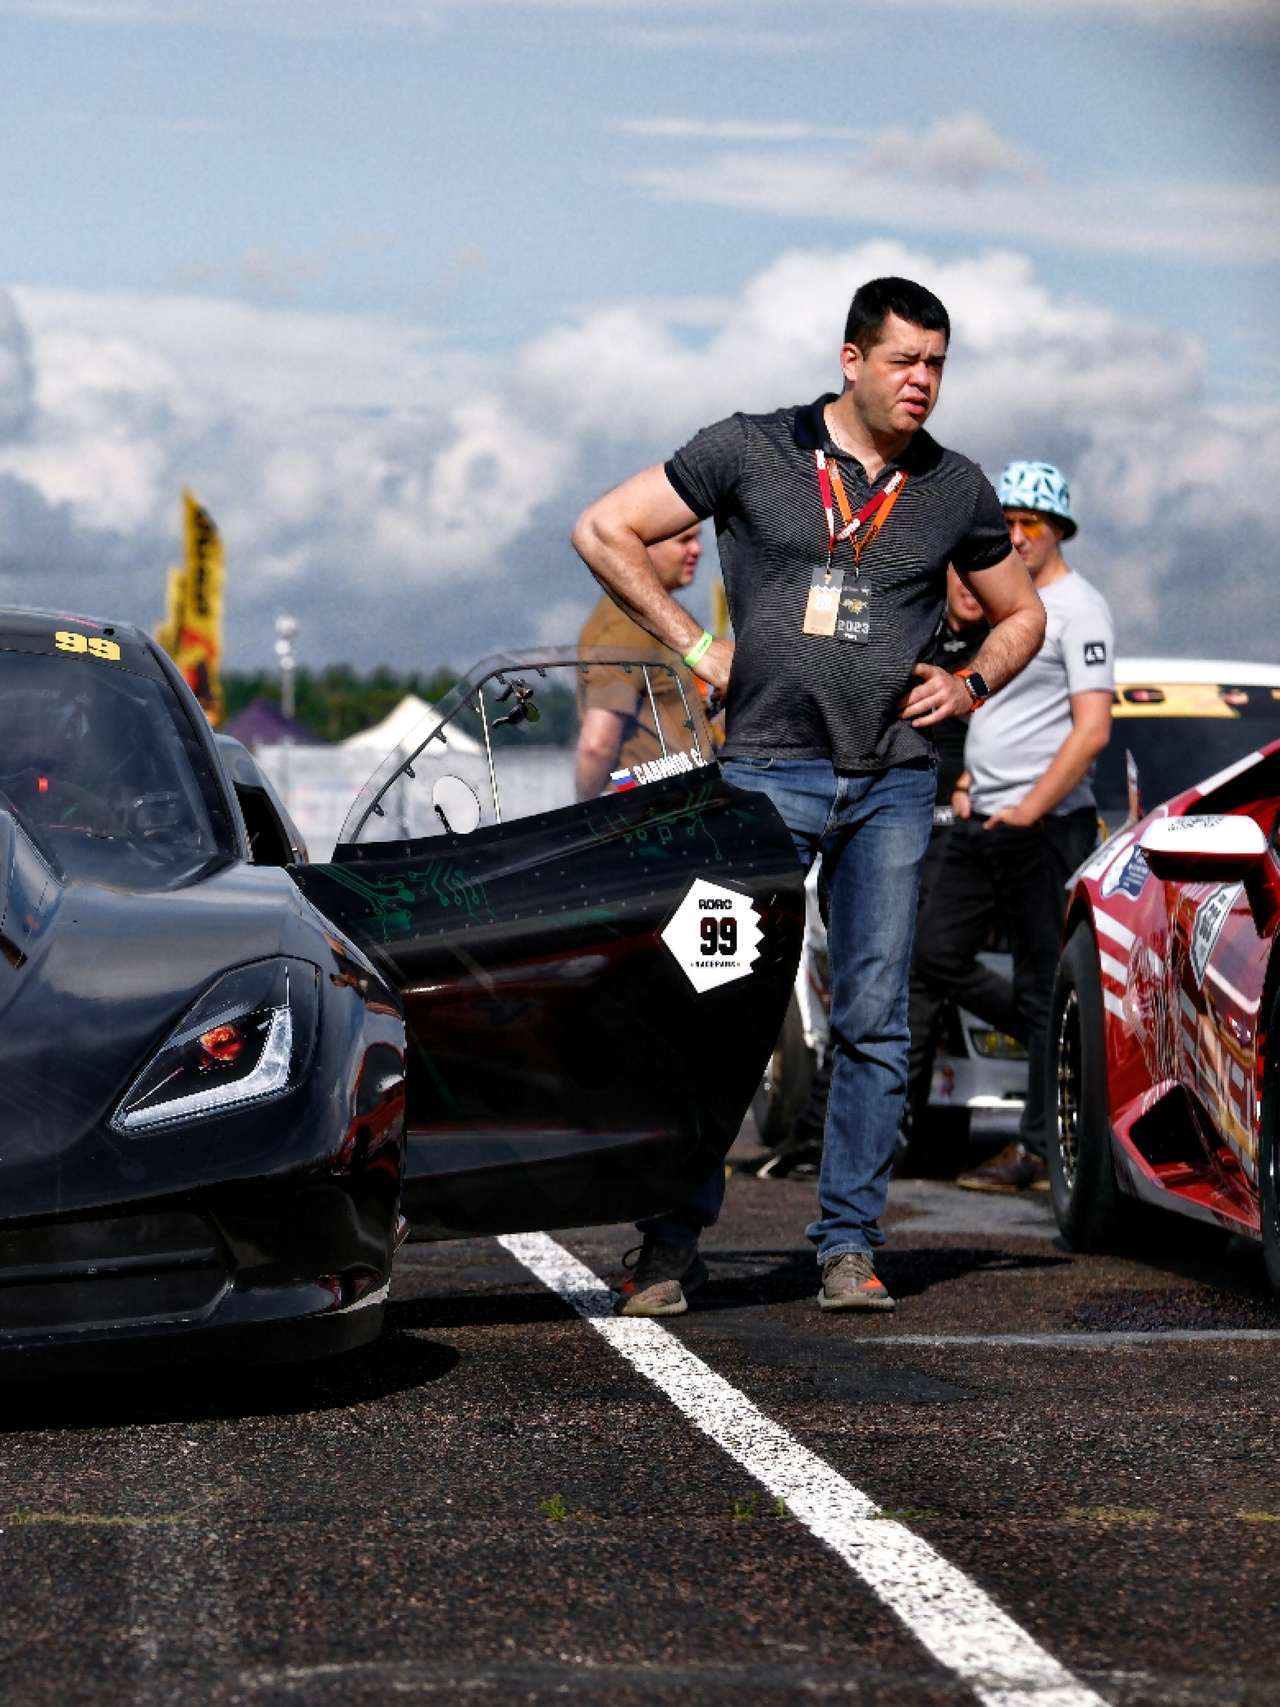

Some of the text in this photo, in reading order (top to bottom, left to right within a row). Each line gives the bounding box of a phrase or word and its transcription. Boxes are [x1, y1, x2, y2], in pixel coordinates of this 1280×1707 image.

[838, 620, 869, 635] 2023
[55, 631, 121, 661] 99
[700, 917, 738, 956] 99
